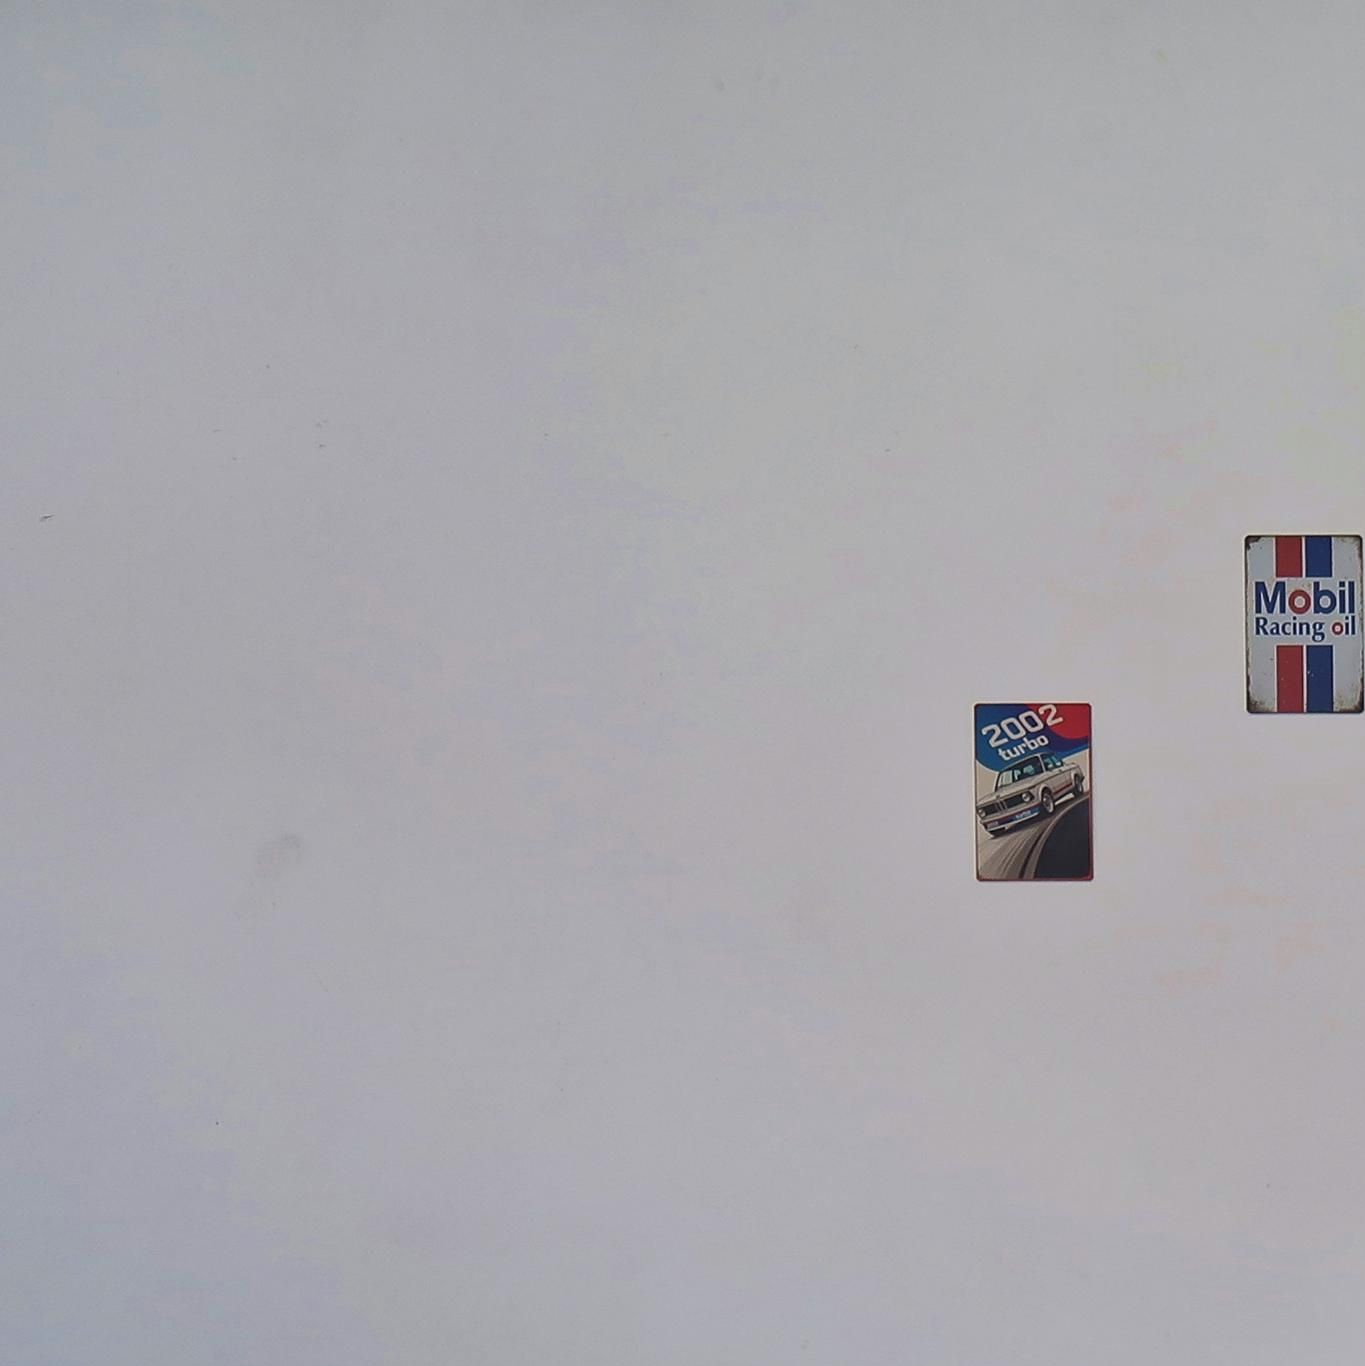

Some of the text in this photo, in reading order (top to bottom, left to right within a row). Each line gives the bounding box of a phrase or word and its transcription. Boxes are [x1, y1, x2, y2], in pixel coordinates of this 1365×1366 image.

[1254, 580, 1356, 614] Mobil
[1254, 615, 1357, 642] Racing oil
[981, 703, 1064, 748] 2002
[998, 734, 1050, 760] turbo
